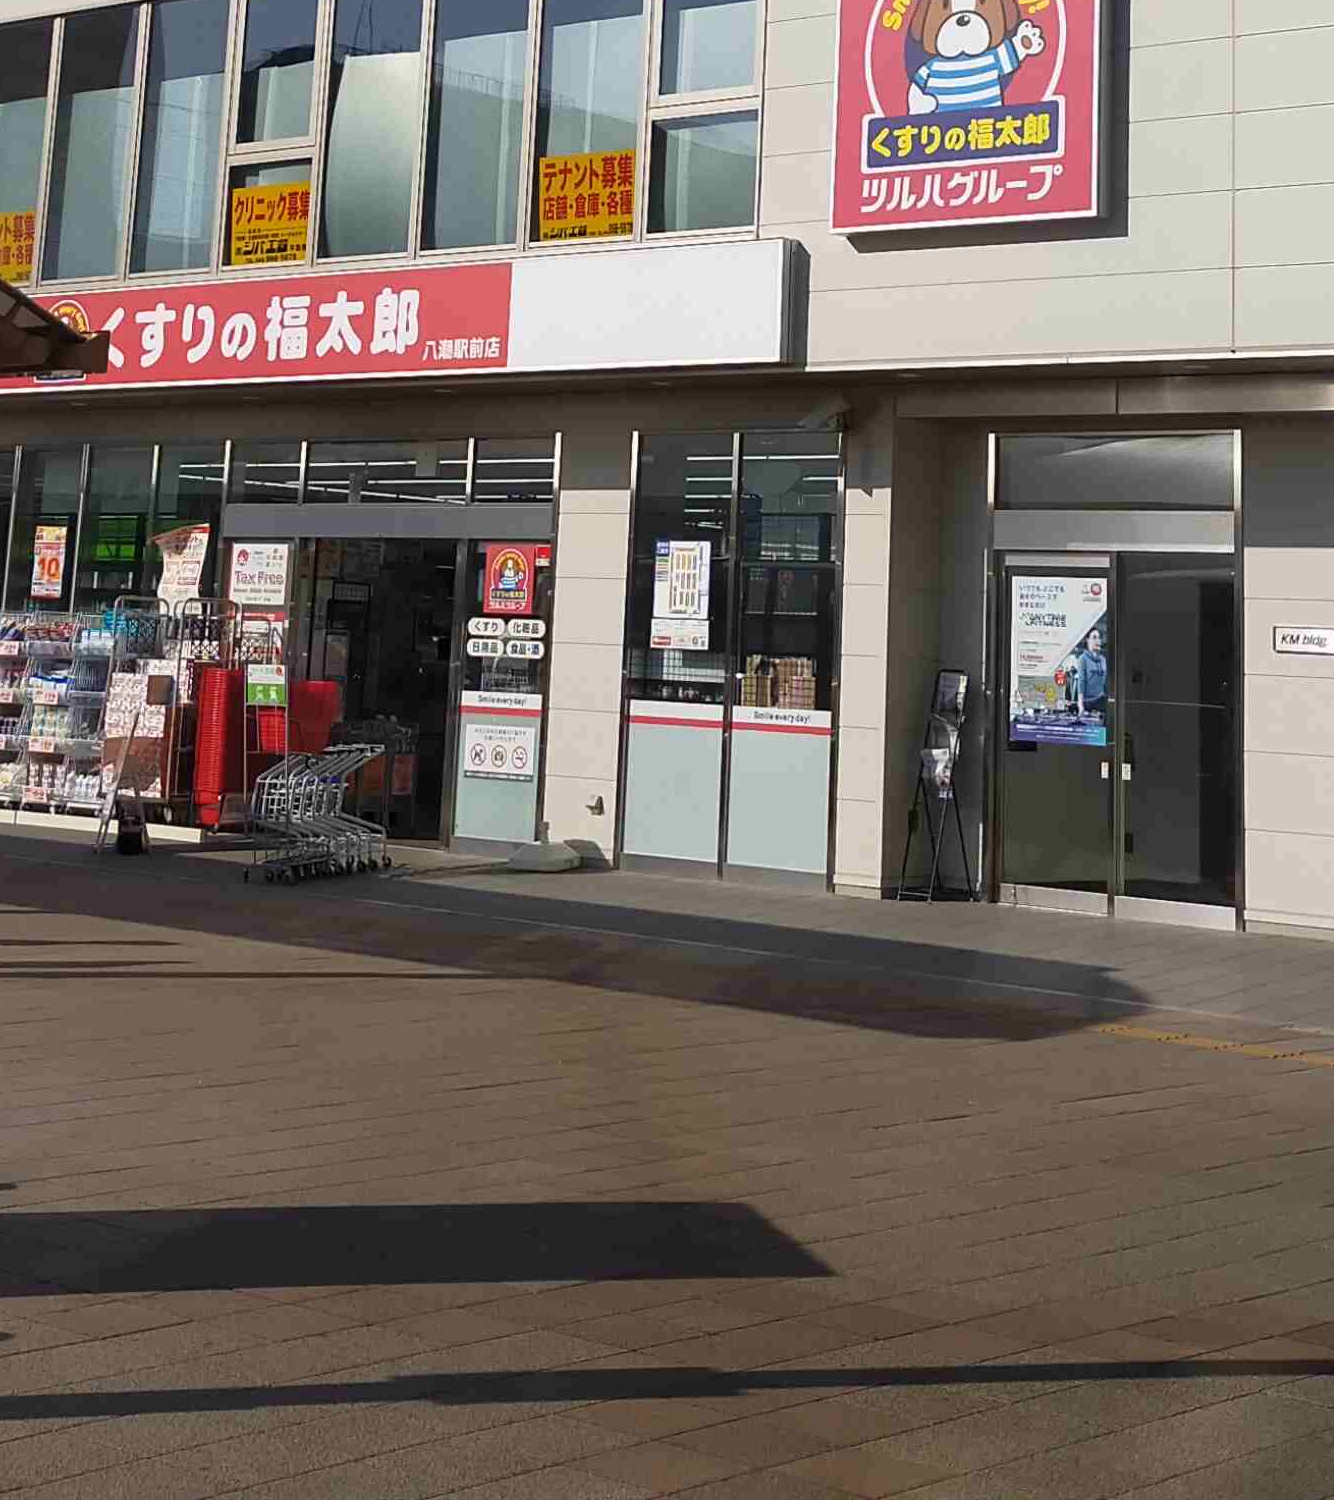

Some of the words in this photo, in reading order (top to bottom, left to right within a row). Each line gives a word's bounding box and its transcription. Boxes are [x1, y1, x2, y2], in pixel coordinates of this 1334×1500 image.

[870, 113, 1051, 158] くすりの福太郎
[543, 153, 633, 192] テナント募集
[860, 163, 1063, 213] ツルハグループ
[235, 189, 310, 226] クリニック募集
[101, 287, 420, 369] くすりの福太郎
[422, 337, 501, 361] 八潮駅前店
[1280, 633, 1301, 645] KM
